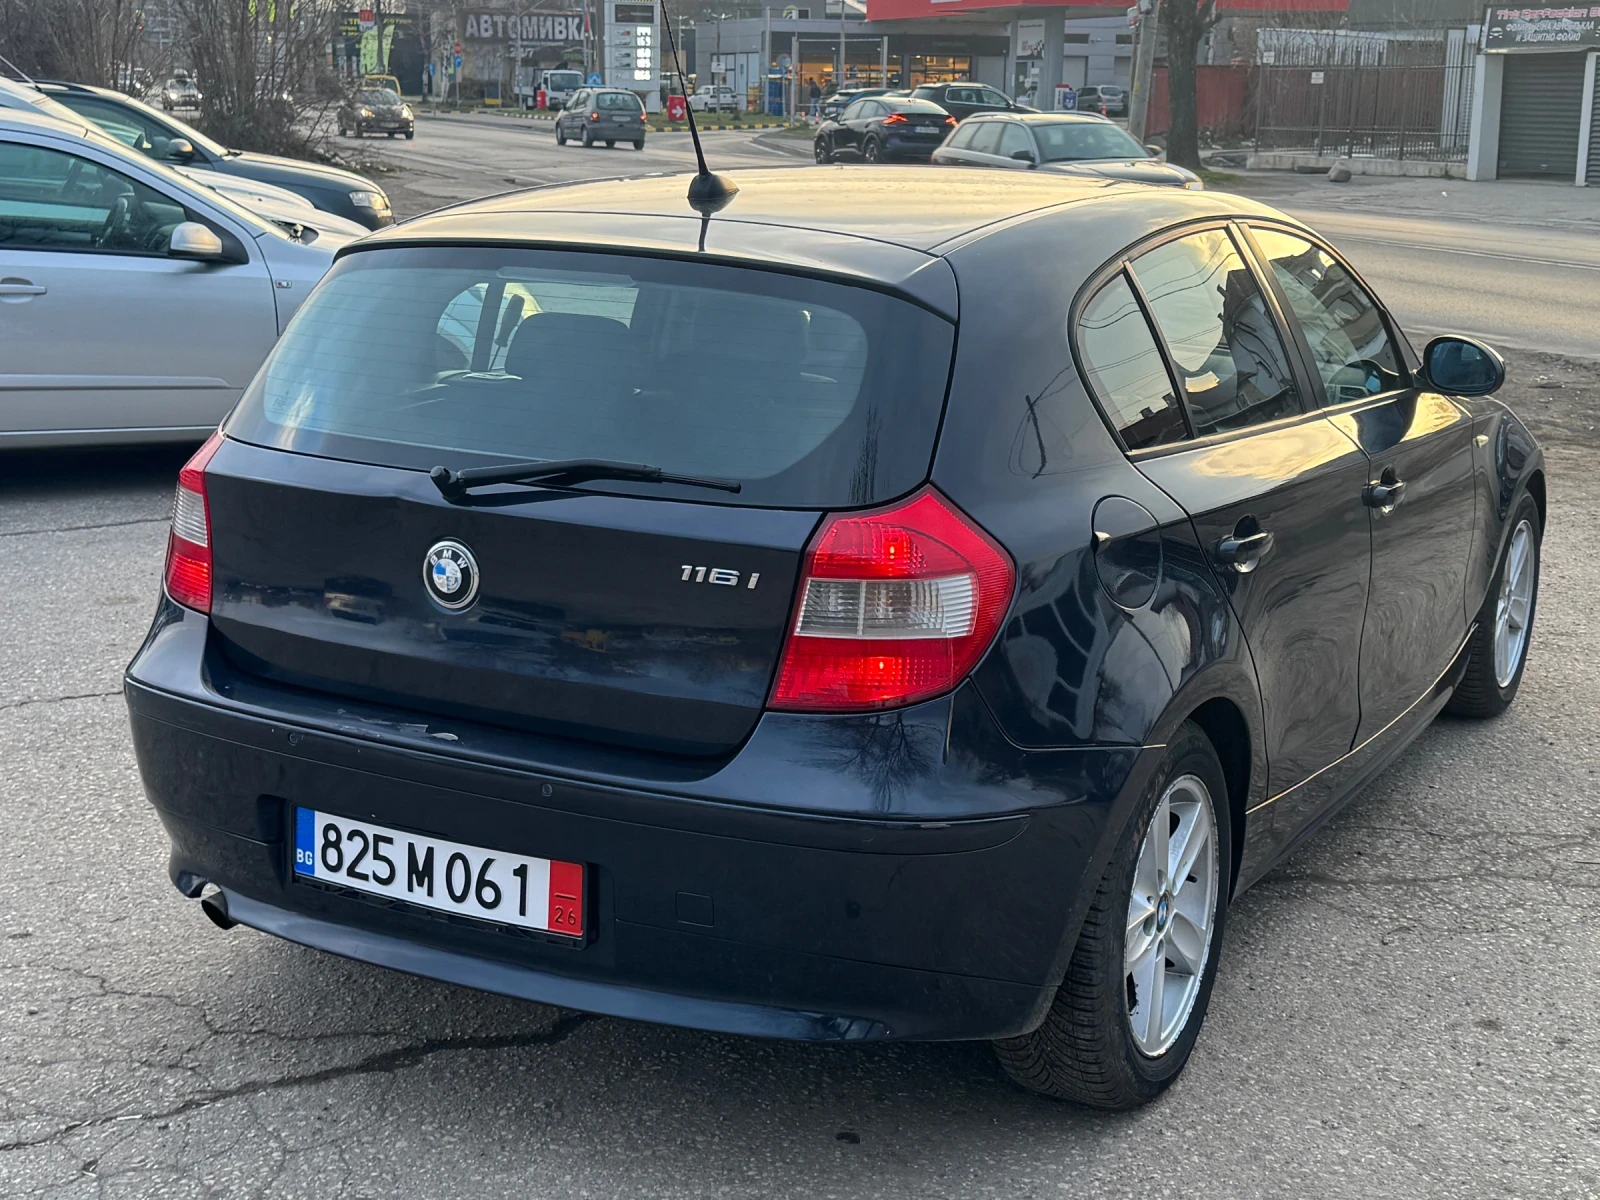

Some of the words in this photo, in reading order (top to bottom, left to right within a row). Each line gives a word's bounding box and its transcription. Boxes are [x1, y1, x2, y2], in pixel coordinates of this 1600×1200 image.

[1521, 7, 1588, 19] Perfection
[429, 549, 468, 569] BMW
[296, 848, 313, 866] BG
[321, 822, 397, 887] 825
[407, 841, 435, 898] M
[445, 851, 529, 917] 061
[554, 905, 577, 926] 26
